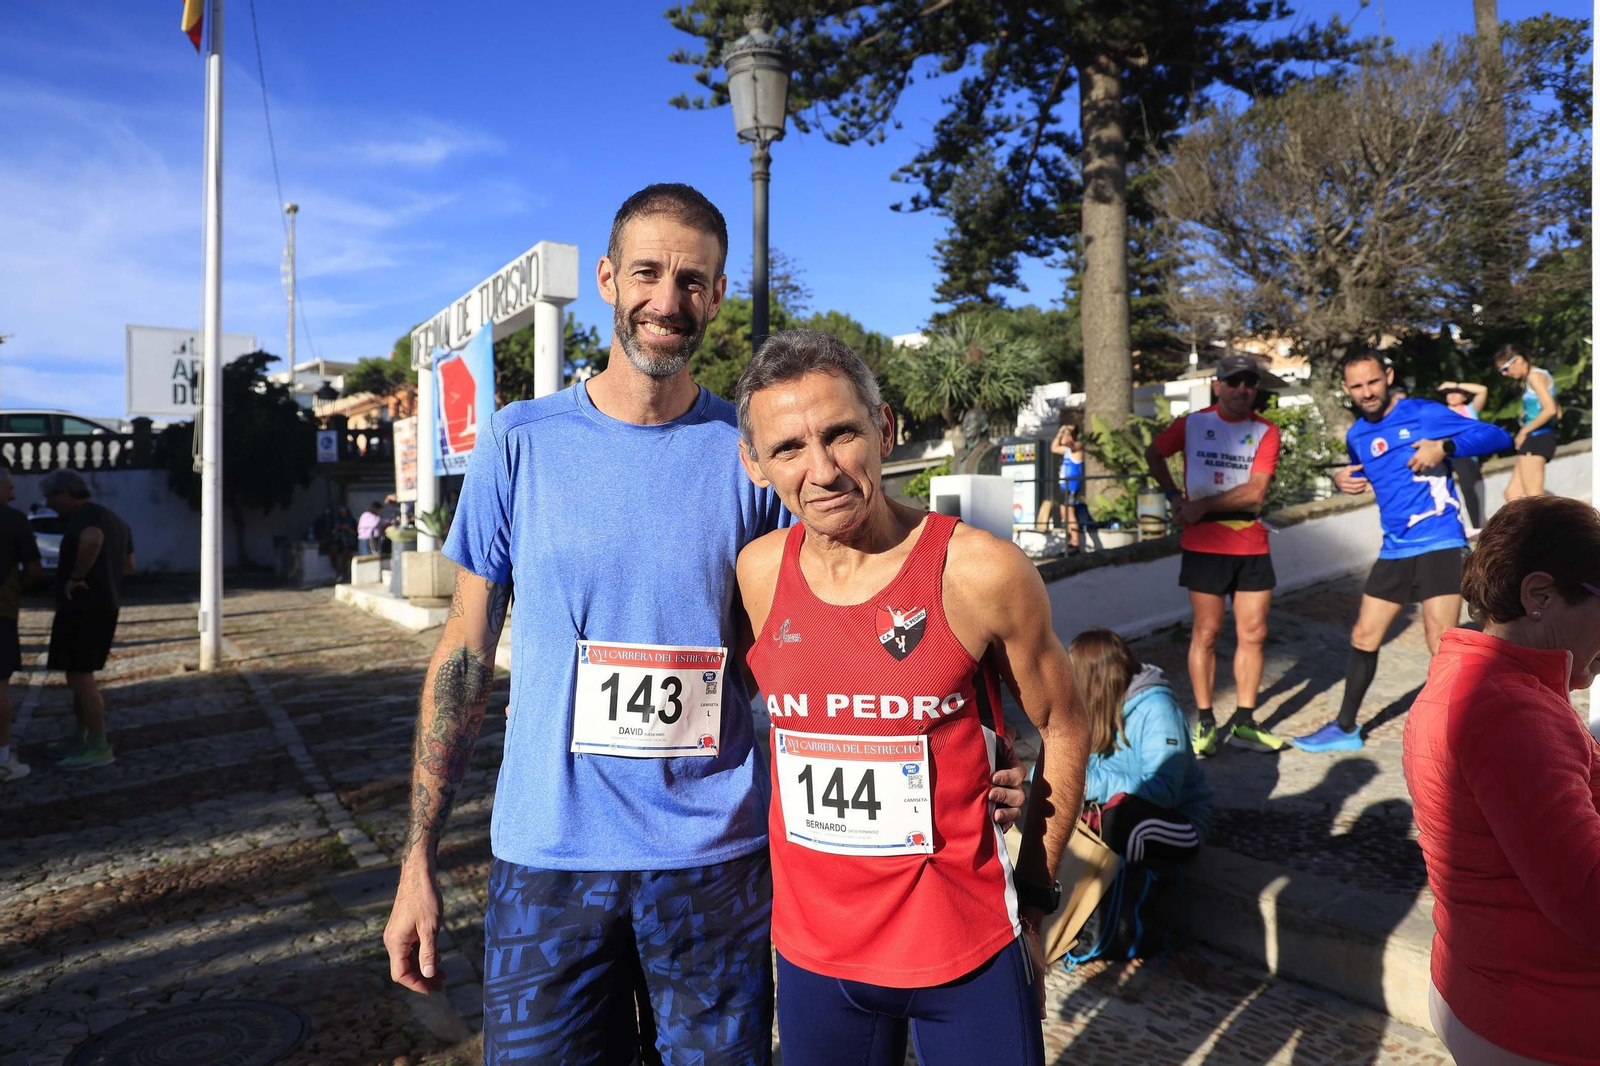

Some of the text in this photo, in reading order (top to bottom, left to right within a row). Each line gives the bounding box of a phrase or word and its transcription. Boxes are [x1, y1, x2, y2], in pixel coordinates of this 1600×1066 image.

[457, 295, 472, 342] DE
[478, 251, 540, 327] TURISMO
[1196, 450, 1218, 459] CLUB
[1204, 459, 1249, 470] ALGECIRAS
[909, 611, 925, 624] PEDRO
[591, 648, 721, 664] XVI CARRERA DEL ESTRECHO
[601, 672, 683, 725] 143
[707, 709, 711, 717] L
[767, 692, 965, 720] AN PEDRO
[618, 726, 643, 736] DAVID
[787, 738, 921, 755] XVI CARRERA DEL ESTRECHO
[798, 764, 881, 820] 144
[914, 805, 919, 813] L
[806, 819, 847, 833] BERNARDO
